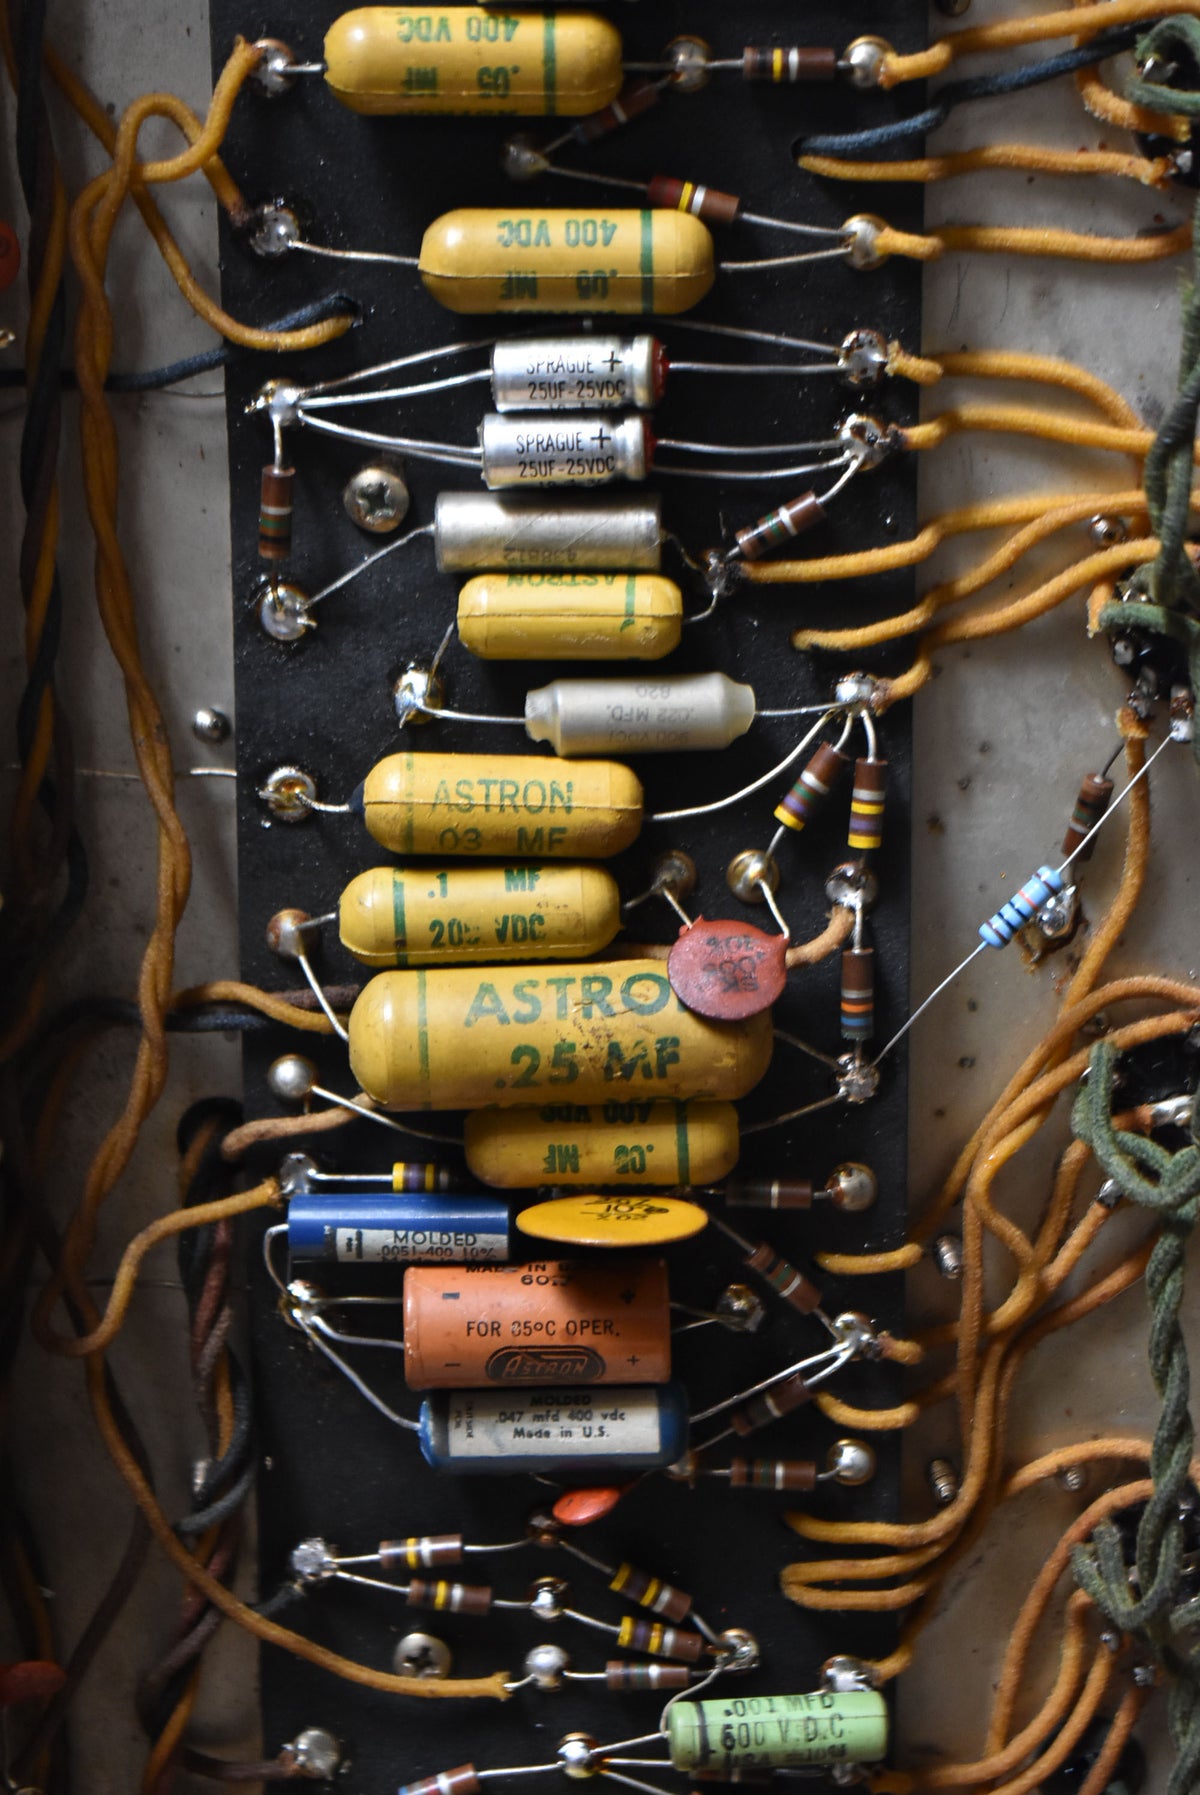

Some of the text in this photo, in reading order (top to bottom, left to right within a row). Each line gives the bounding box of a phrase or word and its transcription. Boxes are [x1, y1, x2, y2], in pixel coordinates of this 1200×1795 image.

[397, 14, 520, 43] 400 VDC
[476, 64, 520, 99] .05
[497, 218, 618, 248] 400 VDC
[499, 269, 538, 300] MF
[526, 353, 595, 375] SPRAGUE
[527, 378, 627, 401] 25UF-25VDC
[516, 431, 584, 454] SPRAGUE
[518, 455, 617, 478] 25UF-25VDC
[432, 778, 574, 815] ASTRON
[516, 827, 568, 853] MF
[427, 867, 543, 898] .1 MF
[495, 912, 546, 944] VDC
[464, 972, 690, 1028] ASTRO
[494, 1036, 681, 1089] .25 MF
[542, 1143, 580, 1174] MF
[393, 1230, 477, 1247] MOLDED
[528, 1263, 548, 1273] IN
[466, 1321, 502, 1337] FOR
[565, 1319, 621, 1337] OPER.
[530, 1395, 592, 1407] MOLDED
[494, 1408, 626, 1424] .047 mfd 400 vdc
[513, 1425, 610, 1439] Made in U.S.
[723, 1695, 835, 1718] .001 MFD
[720, 1722, 766, 1751] 600
